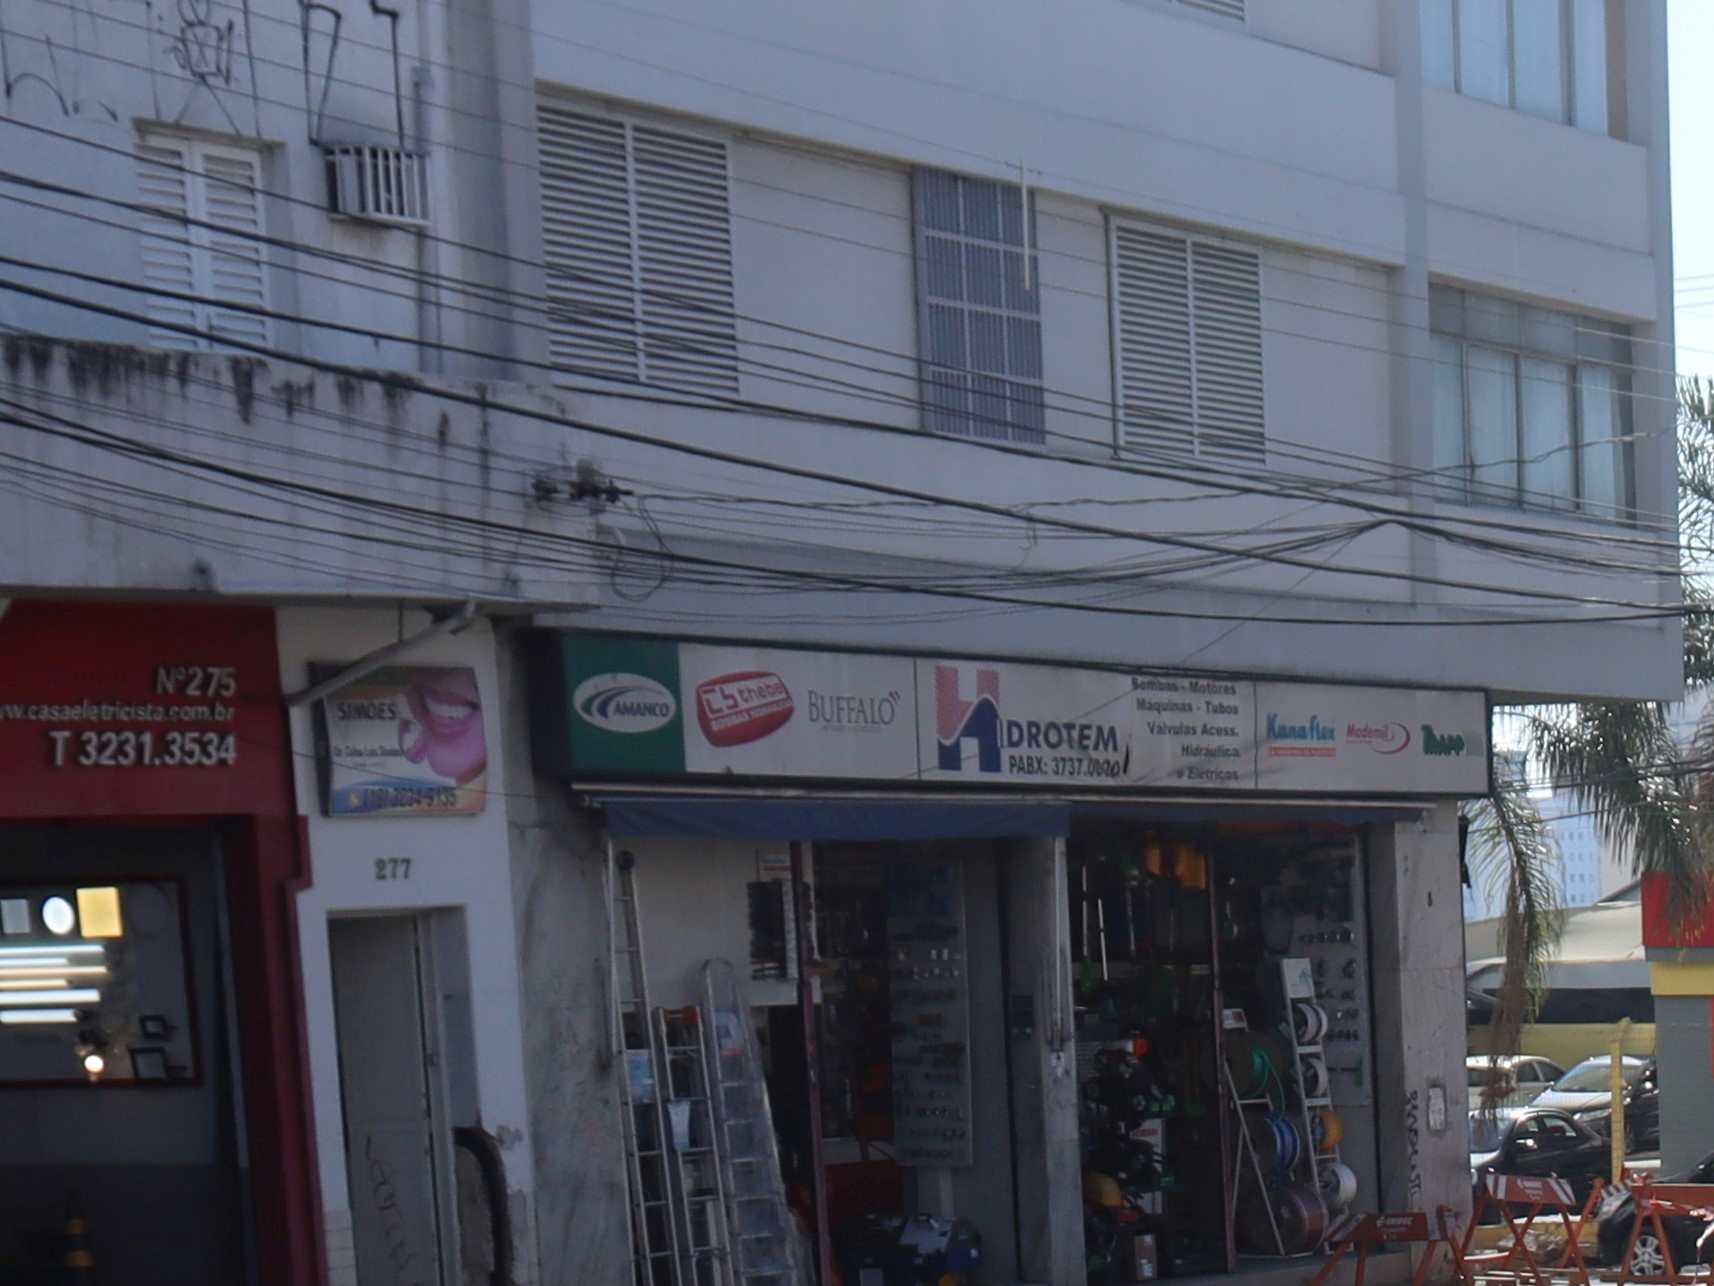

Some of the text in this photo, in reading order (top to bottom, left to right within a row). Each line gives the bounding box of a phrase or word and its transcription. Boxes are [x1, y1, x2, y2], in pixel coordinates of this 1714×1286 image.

[613, 701, 669, 718] AMANCO
[807, 689, 897, 727] BUFFALO
[1205, 700, 1239, 715] Tubos
[49, 731, 237, 766] T 3231.3534
[374, 858, 412, 880] 277
